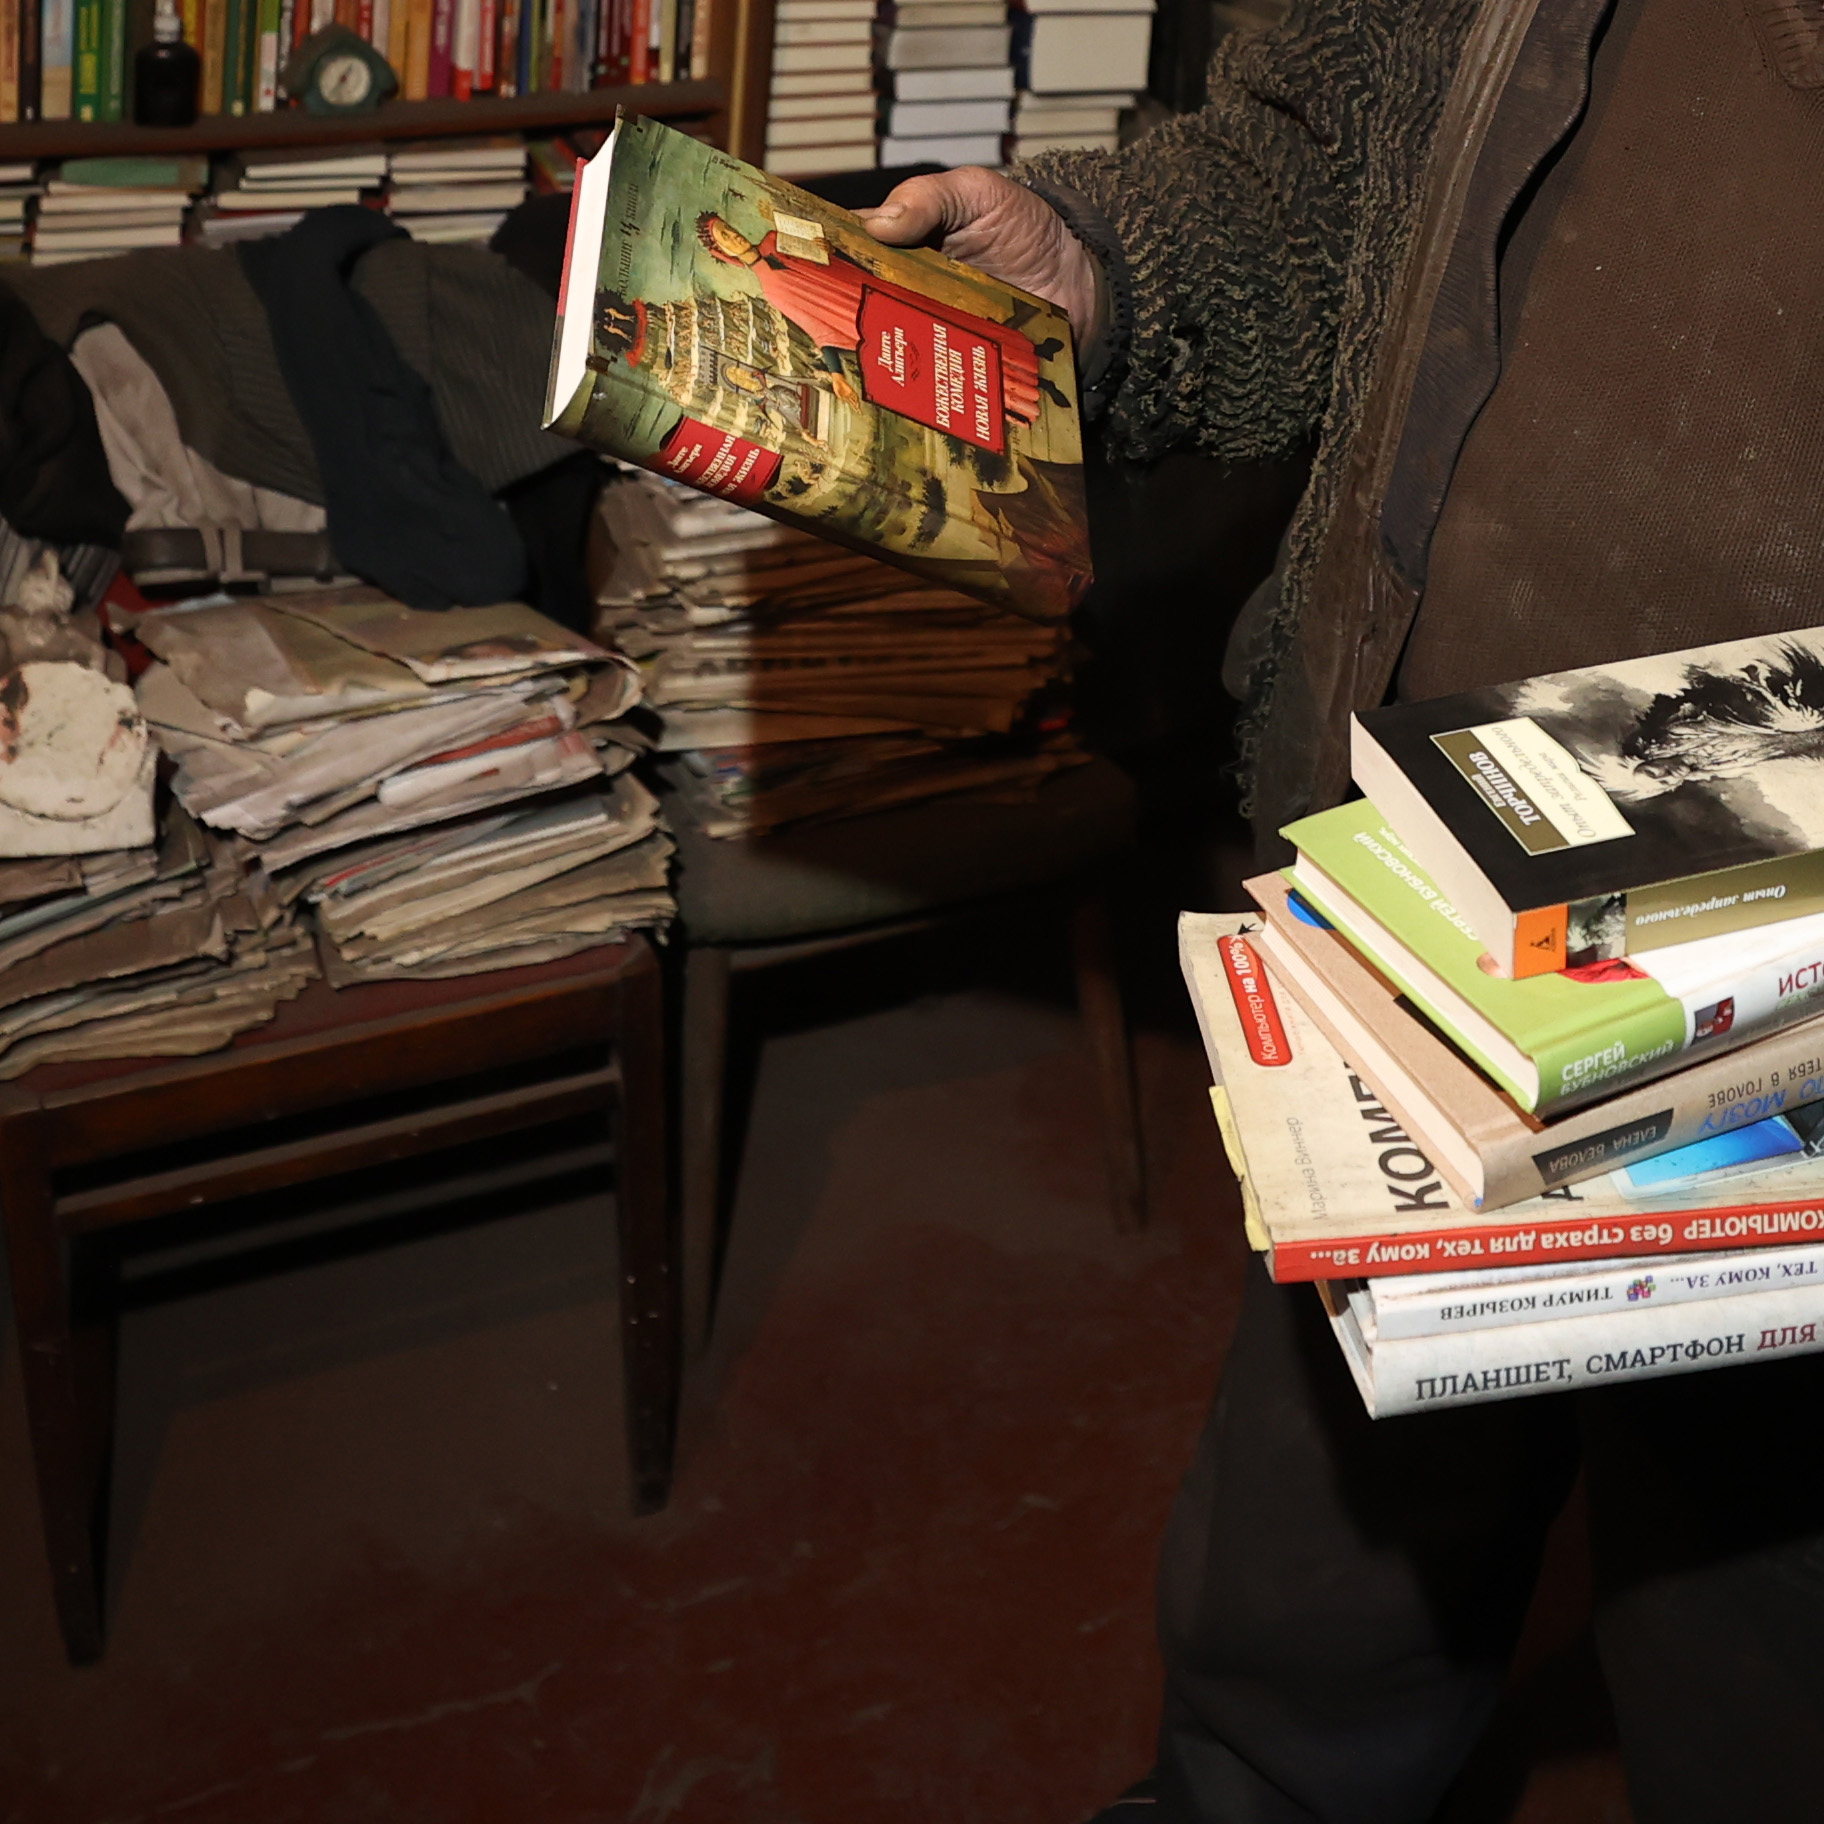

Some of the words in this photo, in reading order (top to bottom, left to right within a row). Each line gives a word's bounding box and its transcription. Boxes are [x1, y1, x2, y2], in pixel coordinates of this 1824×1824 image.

[878, 331, 894, 372] Данте
[891, 327, 907, 387] Алигьери
[933, 323, 950, 428] БОЖЕСТВЕННАЯ
[949, 347, 966, 414] КОМЕДИЯ
[972, 345, 988, 393] ЖИЗНЬ
[975, 393, 990, 441] НОВАЯ
[733, 448, 760, 484] ЖИЗНЬ
[1492, 727, 1564, 804] запредельного
[1468, 751, 1542, 826] ТОРЧИНОВ
[1559, 803, 1596, 838] Опыт
[1352, 832, 1438, 901] БУБНОВСКИЙ
[1635, 894, 1740, 927] запредельного
[1743, 884, 1787, 903] Опыт
[1430, 898, 1479, 941] СЕРГЕЙ
[1230, 942, 1253, 976] 100%
[1241, 976, 1258, 994] на
[1247, 994, 1279, 1061] Компьютер
[1560, 1039, 1675, 1096] БУБНОВСКИЙ
[1562, 1041, 1626, 1082] СЕРГЕЙ
[1788, 1058, 1823, 1080] ТЕБЯ
[1708, 1080, 1762, 1109] ГОЛОВЕ
[1771, 1072, 1781, 1087] В
[1697, 1088, 1787, 1135] МОЗГУ
[1286, 1117, 1313, 1165] Виннер
[1612, 1125, 1657, 1151] ЕЛЕНА
[1549, 1143, 1605, 1174] БЕЛОВА
[1302, 1166, 1328, 1221] Марина
[1436, 1238, 1483, 1259] тех,
[1490, 1230, 1536, 1254] для
[1540, 1225, 1624, 1250] страха
[1630, 1222, 1673, 1244] без
[1310, 1248, 1361, 1266] за...
[1366, 1242, 1430, 1265] кому
[1776, 1259, 1818, 1278] ТЕХ,
[1669, 1274, 1710, 1290] ЗА...
[1714, 1266, 1771, 1287] КОМУ
[1439, 1295, 1537, 1322] КОЗЫРЕВ
[1542, 1285, 1614, 1308] ТИМУР
[1415, 1358, 1574, 1402] ПЛАНШЕТ,
[1585, 1333, 1745, 1375] СМАРТФОН
[1757, 1324, 1817, 1351] ДЛЯ
